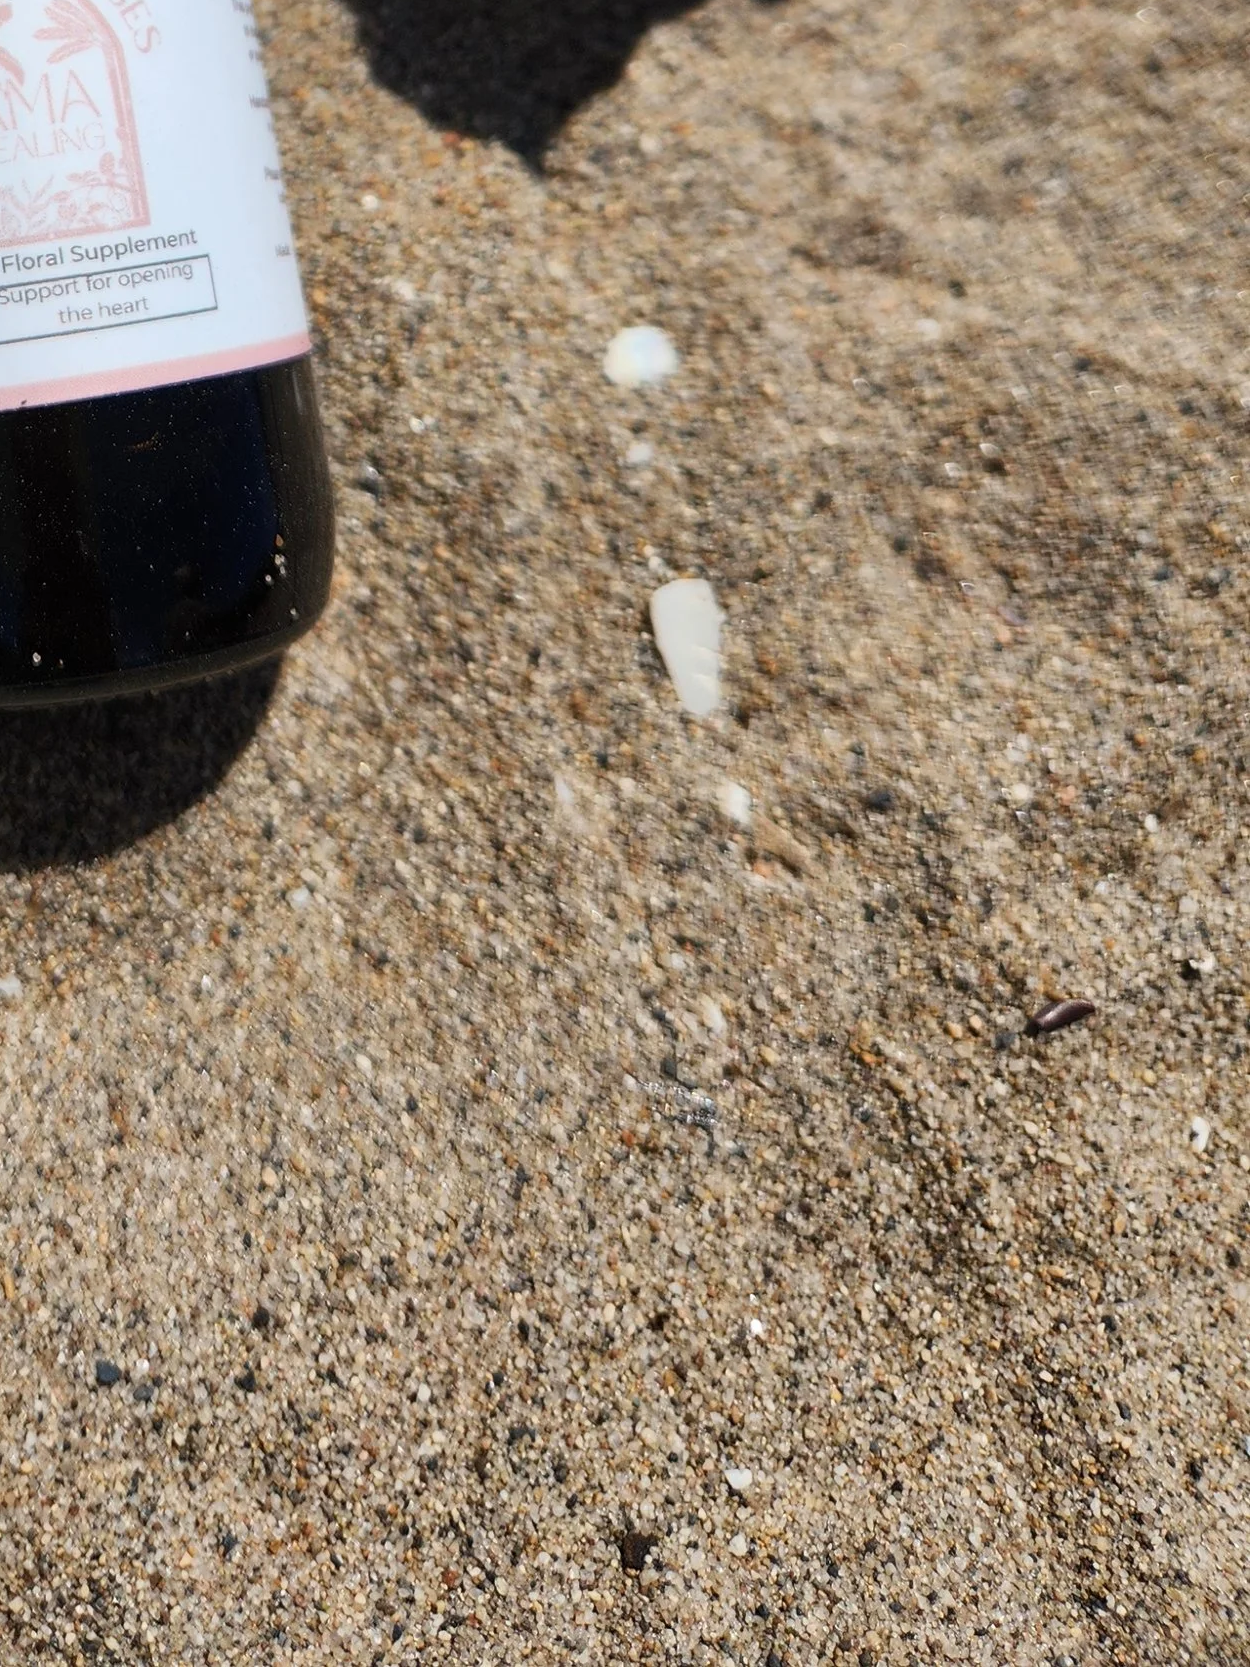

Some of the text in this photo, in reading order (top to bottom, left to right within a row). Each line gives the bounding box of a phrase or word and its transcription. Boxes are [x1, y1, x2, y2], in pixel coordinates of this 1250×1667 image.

[0, 247, 64, 274] Floral
[70, 229, 199, 263] Supplement
[86, 274, 111, 292] for
[118, 262, 194, 287] opening
[58, 297, 149, 325] the heart
